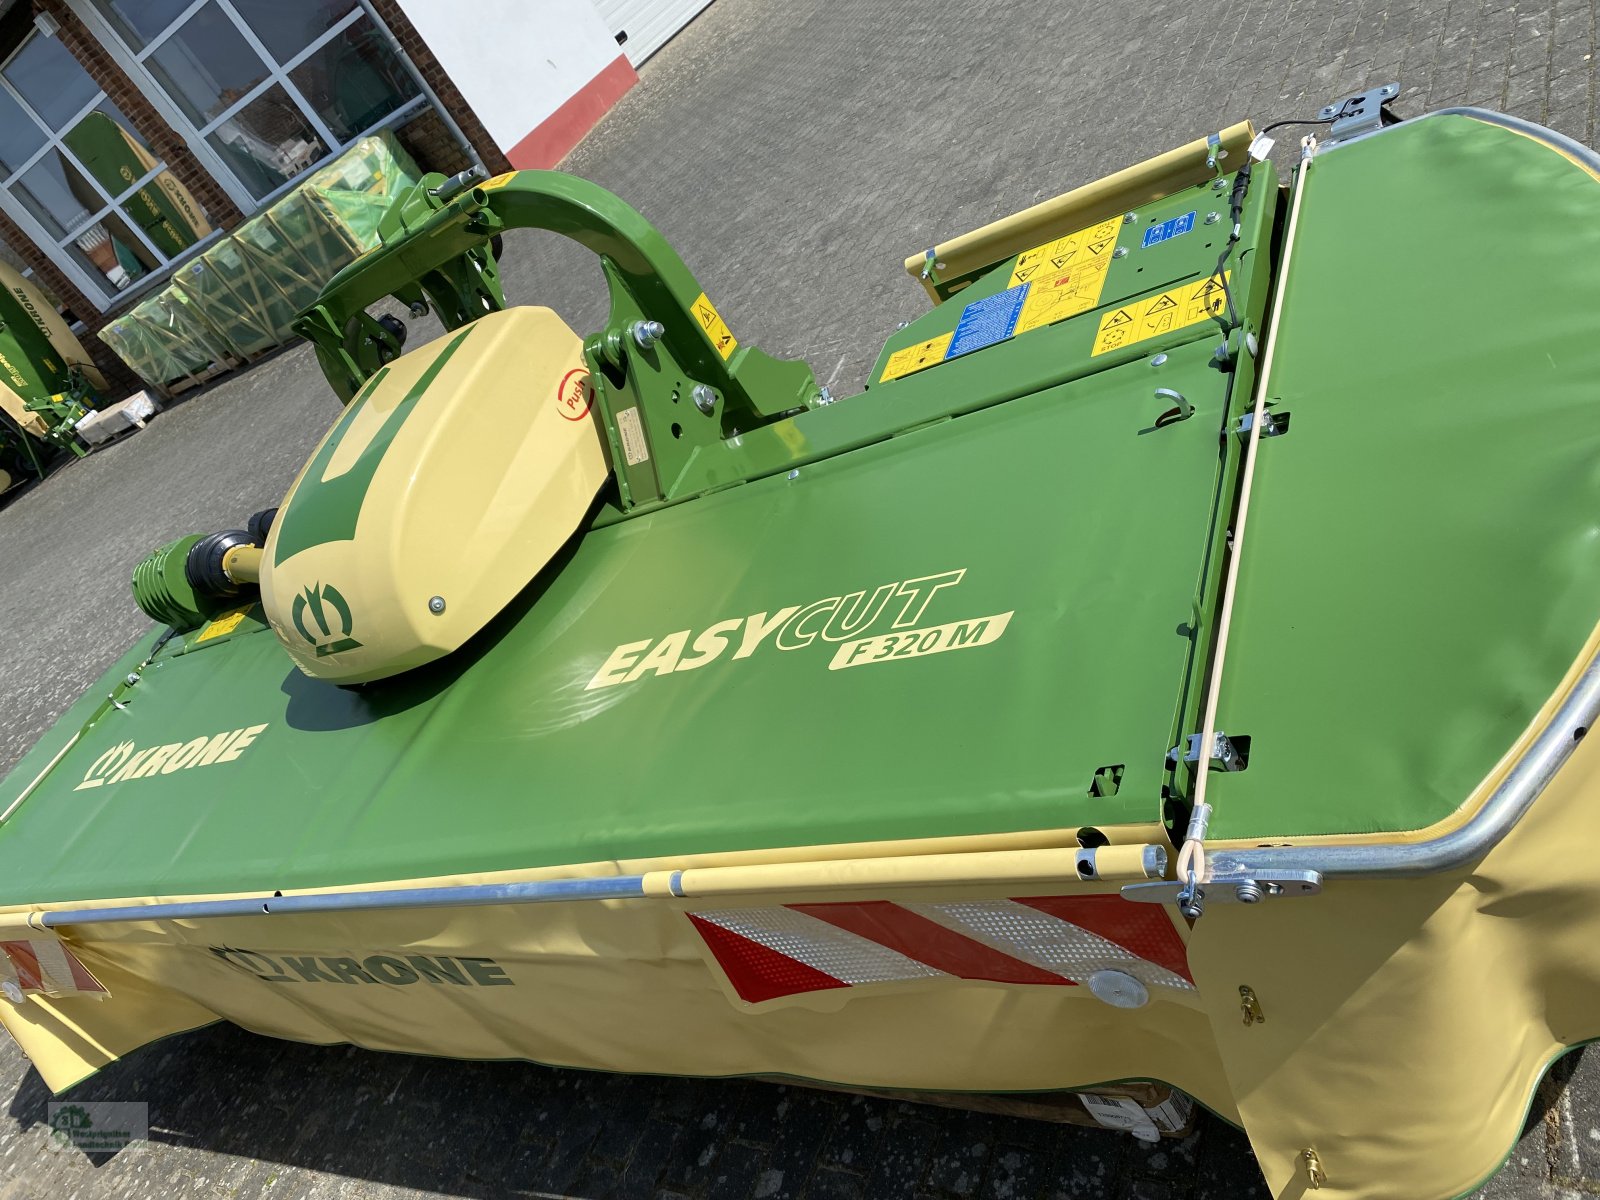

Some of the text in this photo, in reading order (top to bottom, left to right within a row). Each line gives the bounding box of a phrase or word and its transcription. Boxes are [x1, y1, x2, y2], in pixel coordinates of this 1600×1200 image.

[13, 287, 45, 328] KRONE
[1101, 341, 1122, 352] STOP
[567, 380, 585, 410] Push
[584, 567, 968, 691] EASYCUT
[846, 620, 991, 665] F 320 M
[106, 723, 269, 785] KRONE
[280, 955, 516, 986] KRONE
